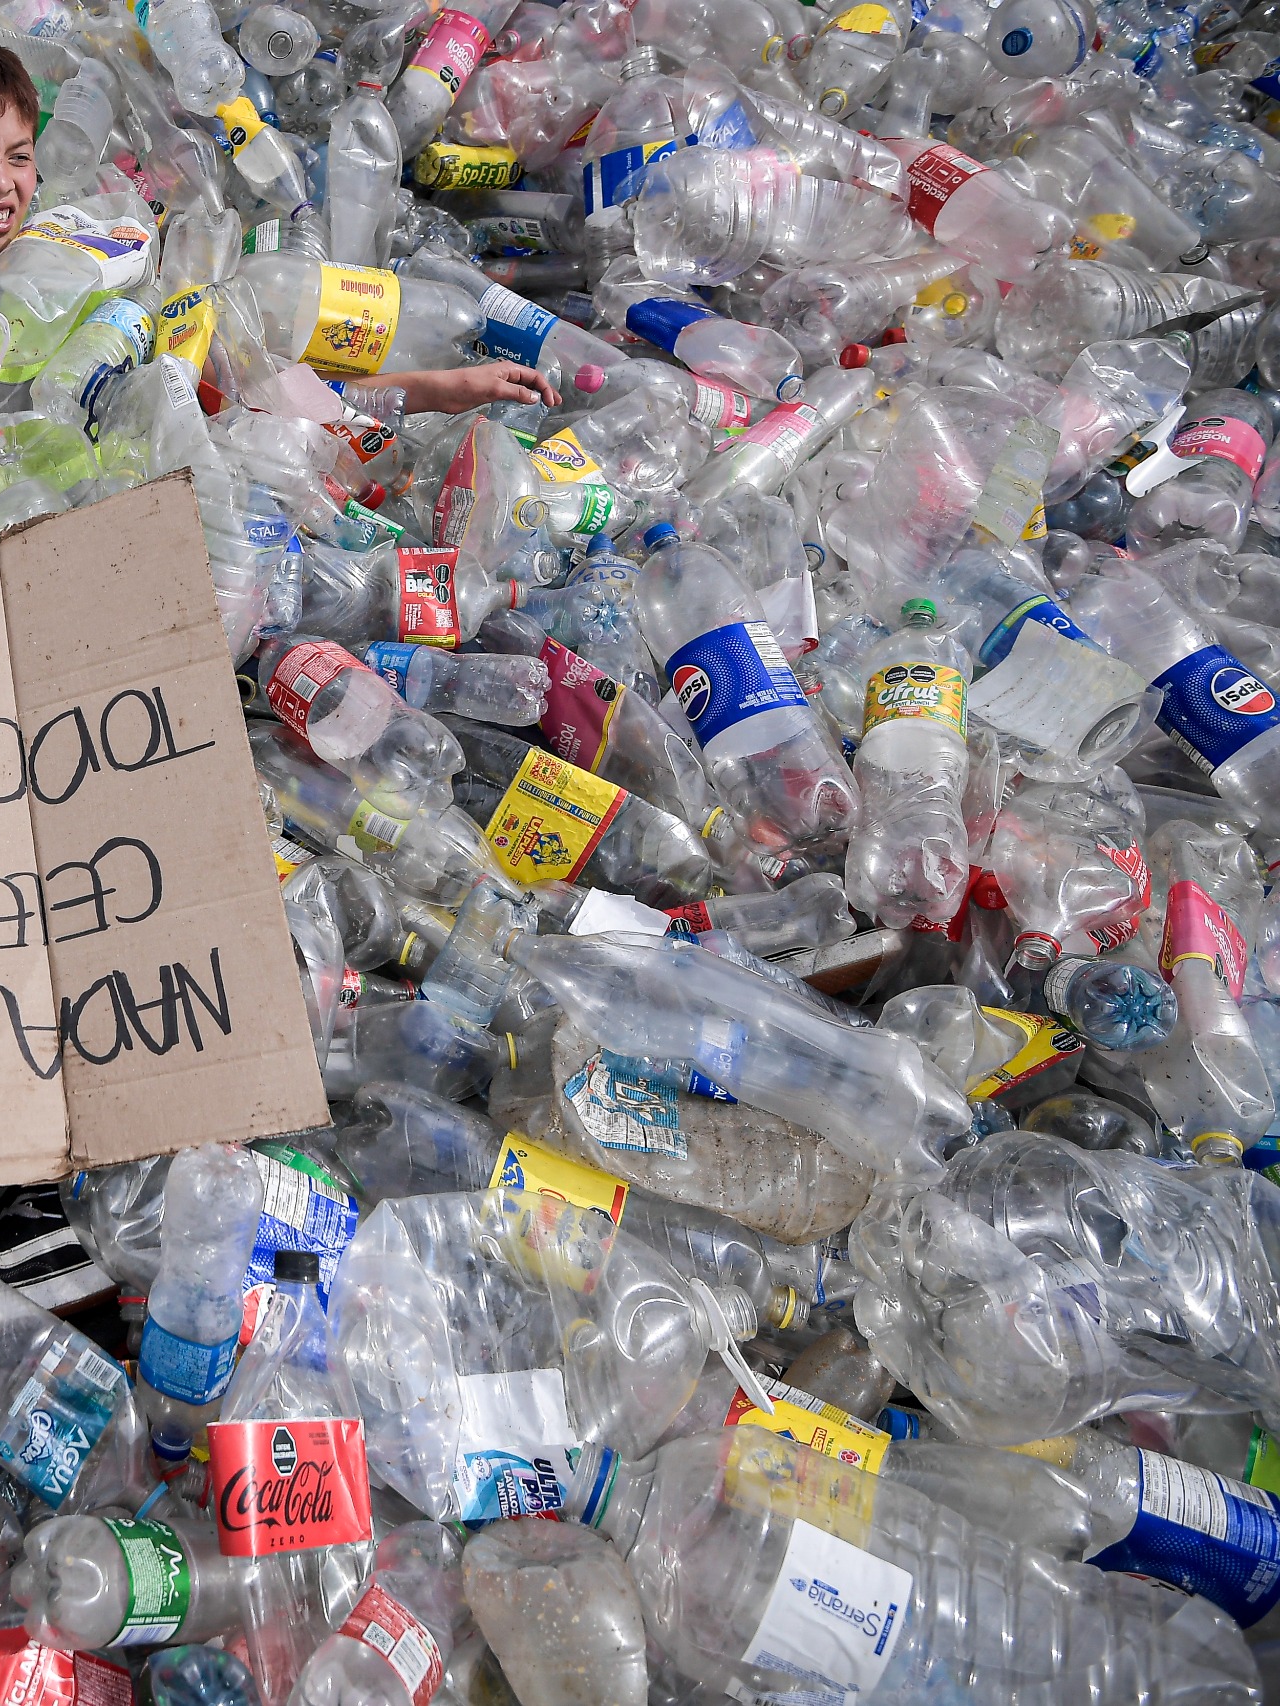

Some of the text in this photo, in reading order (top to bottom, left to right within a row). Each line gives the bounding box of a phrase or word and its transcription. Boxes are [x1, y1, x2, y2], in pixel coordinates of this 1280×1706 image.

[460, 164, 508, 188] SPEED
[493, 344, 522, 362] pepsi
[588, 485, 611, 532] Sprite
[405, 578, 435, 593] BIG
[1219, 679, 1266, 706] PEPSI
[41, 1425, 91, 1495] AGUA
[220, 1460, 335, 1532] Coca-Cola
[495, 1480, 511, 1520] ANTIBA
[503, 1469, 520, 1515] LAVALOZ
[533, 1457, 563, 1511] ULTR
[270, 1534, 306, 1548] ZERO
[807, 1584, 882, 1638] Serranía
